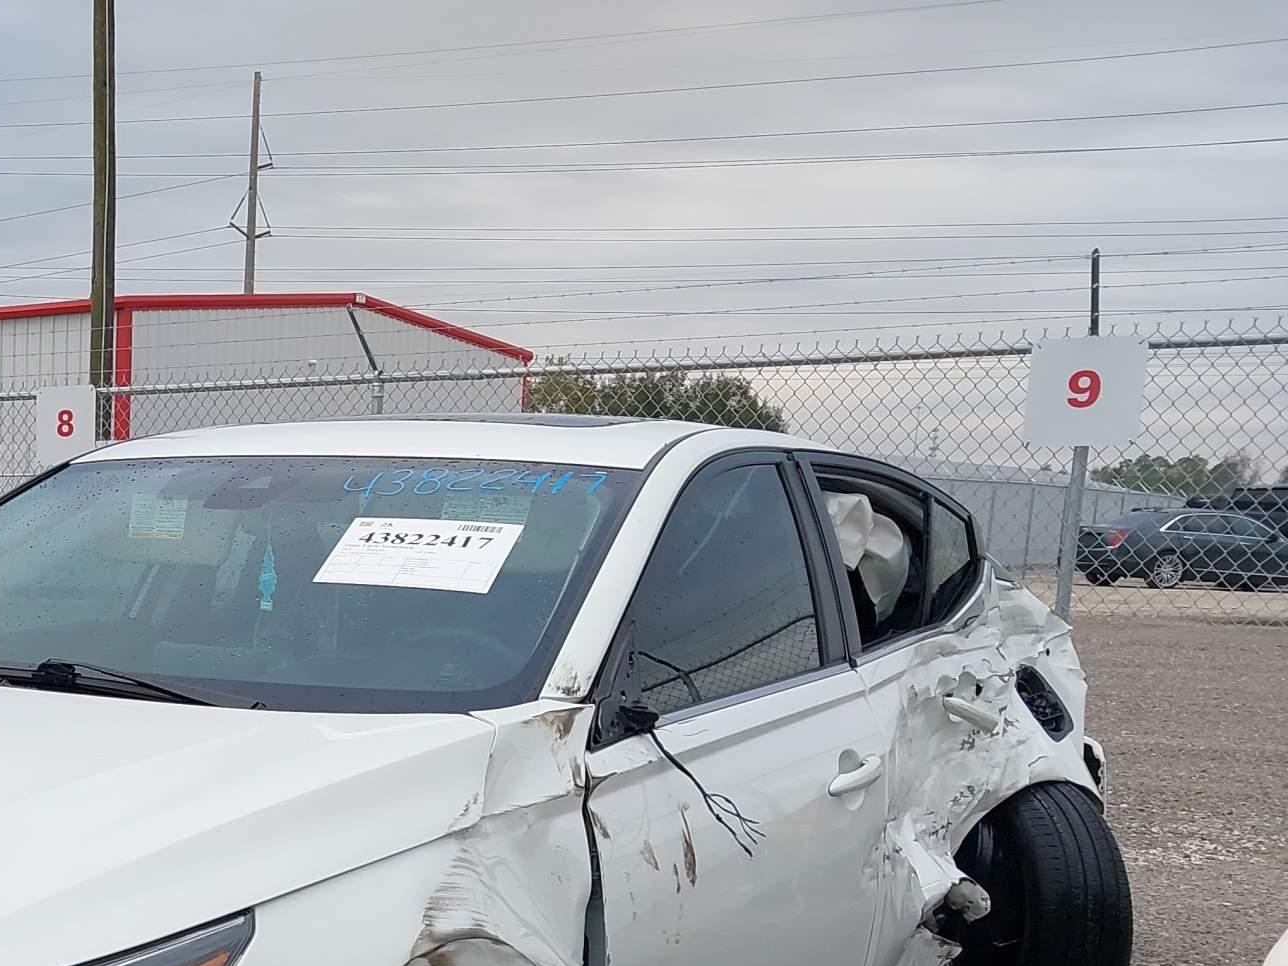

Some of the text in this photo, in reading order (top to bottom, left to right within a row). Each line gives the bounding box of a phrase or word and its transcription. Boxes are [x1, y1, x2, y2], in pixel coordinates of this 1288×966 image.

[1067, 369, 1102, 409] 9
[56, 409, 74, 437] 8
[344, 467, 609, 498] 43822417
[358, 531, 495, 550] 43822417
